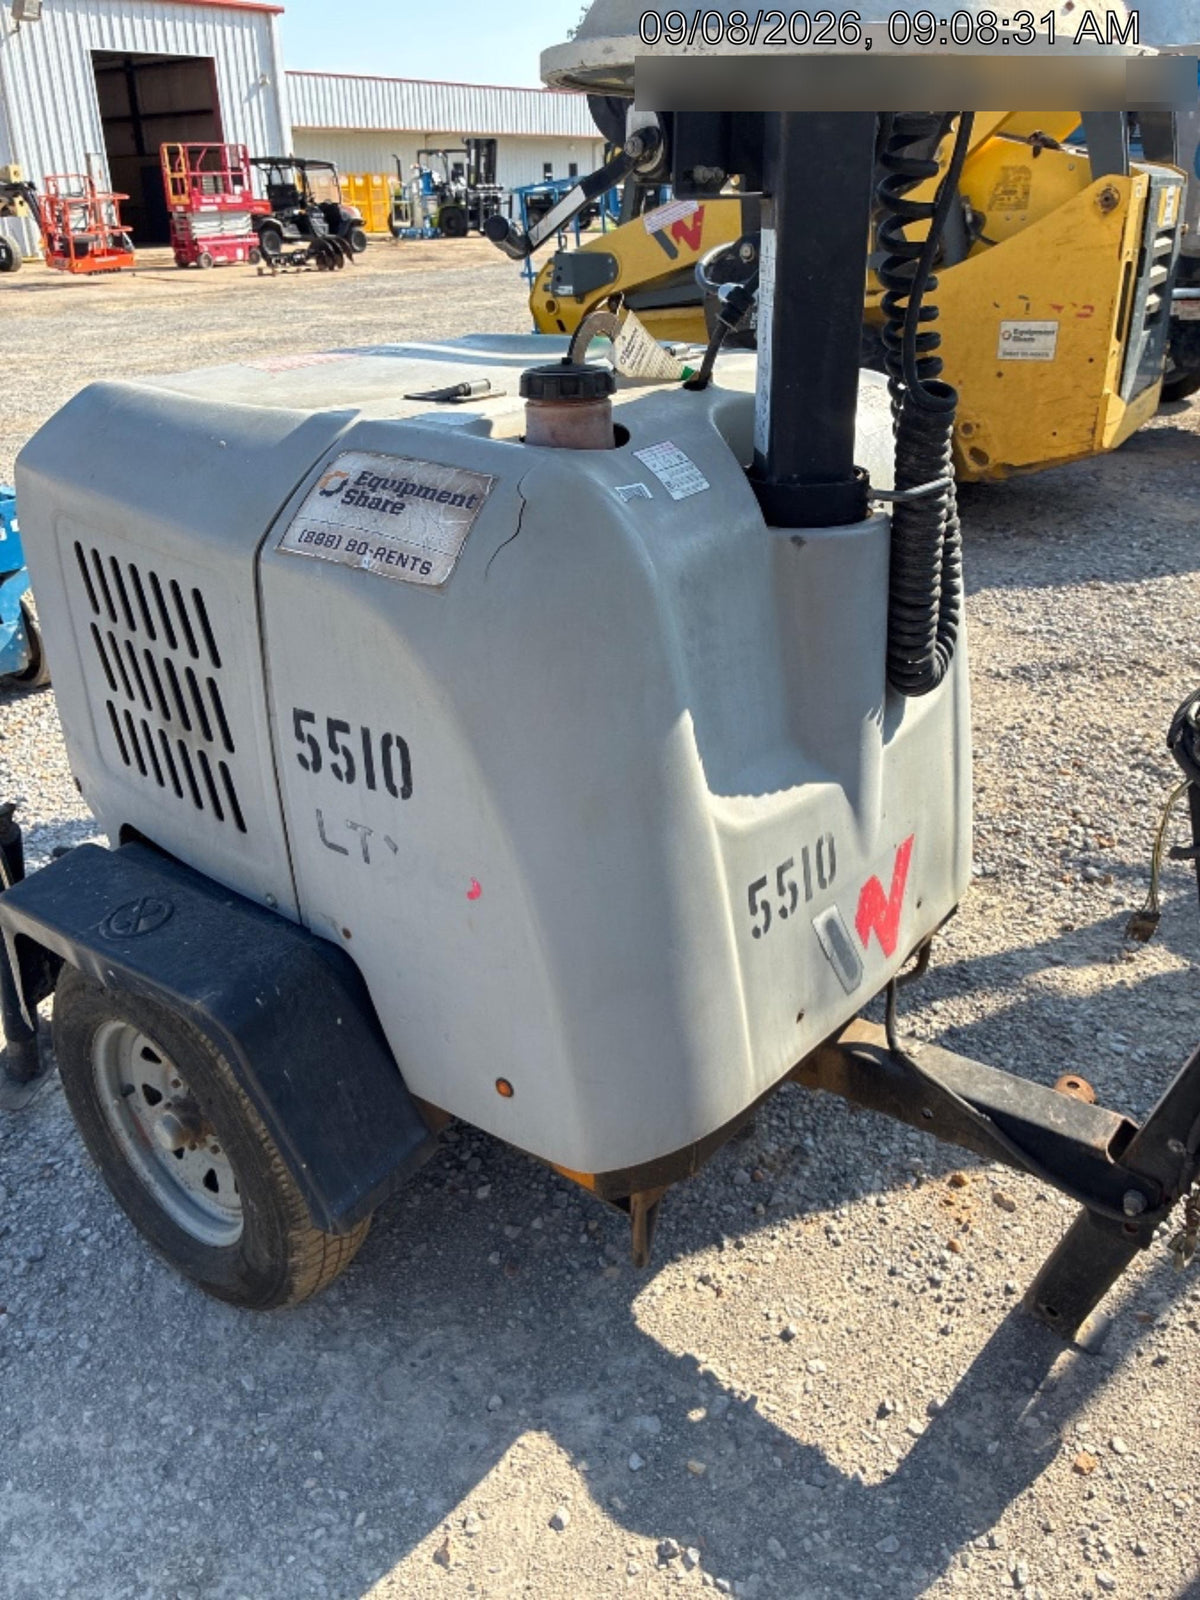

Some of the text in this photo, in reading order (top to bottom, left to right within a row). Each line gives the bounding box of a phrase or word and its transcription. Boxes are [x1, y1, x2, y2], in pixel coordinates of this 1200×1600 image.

[340, 488, 407, 516] Share
[353, 470, 480, 510] Equipment
[297, 528, 434, 576] (888) 80-RENTS
[292, 706, 413, 800] 5510
[747, 832, 837, 940] 5510
